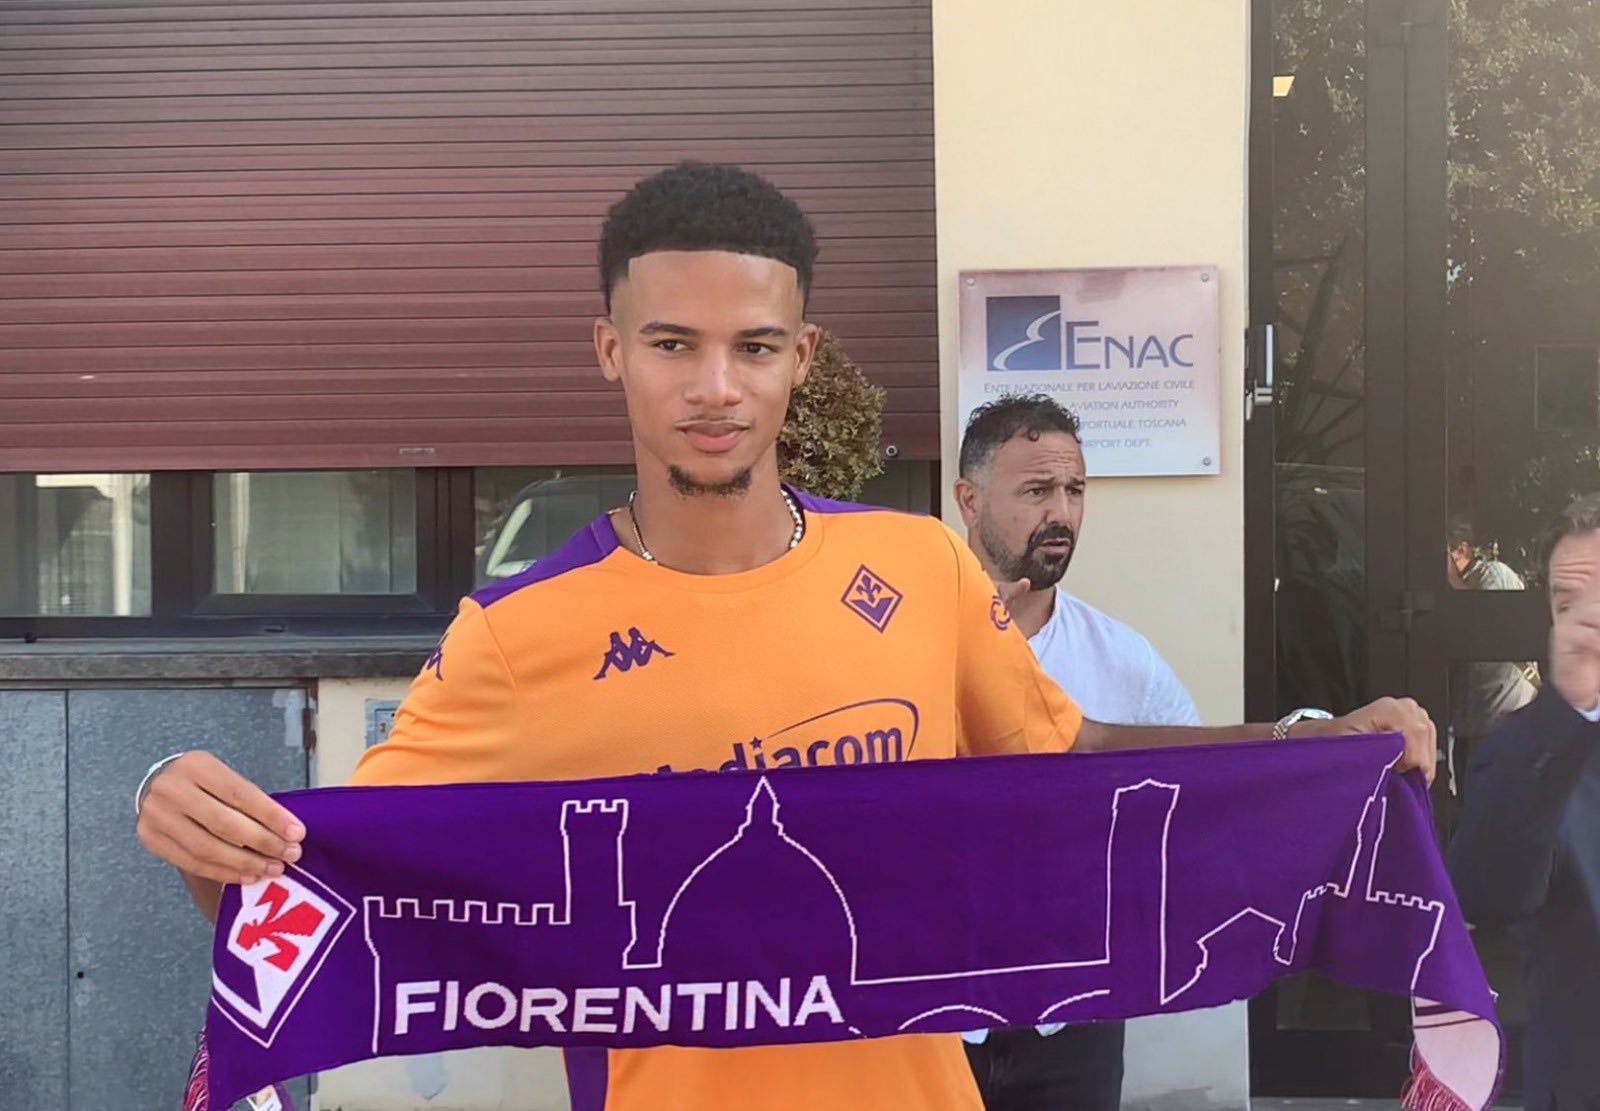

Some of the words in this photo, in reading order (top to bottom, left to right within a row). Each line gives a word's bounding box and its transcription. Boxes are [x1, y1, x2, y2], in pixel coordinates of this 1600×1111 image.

[1065, 320, 1195, 370] ENAC
[1076, 381, 1096, 392] PER
[1163, 379, 1195, 390] CIVILE
[1121, 399, 1180, 410] AUTHORITY
[1137, 418, 1187, 429] TOSCANA
[652, 727, 903, 775] diacom
[394, 975, 844, 1035] FIORENTINA
